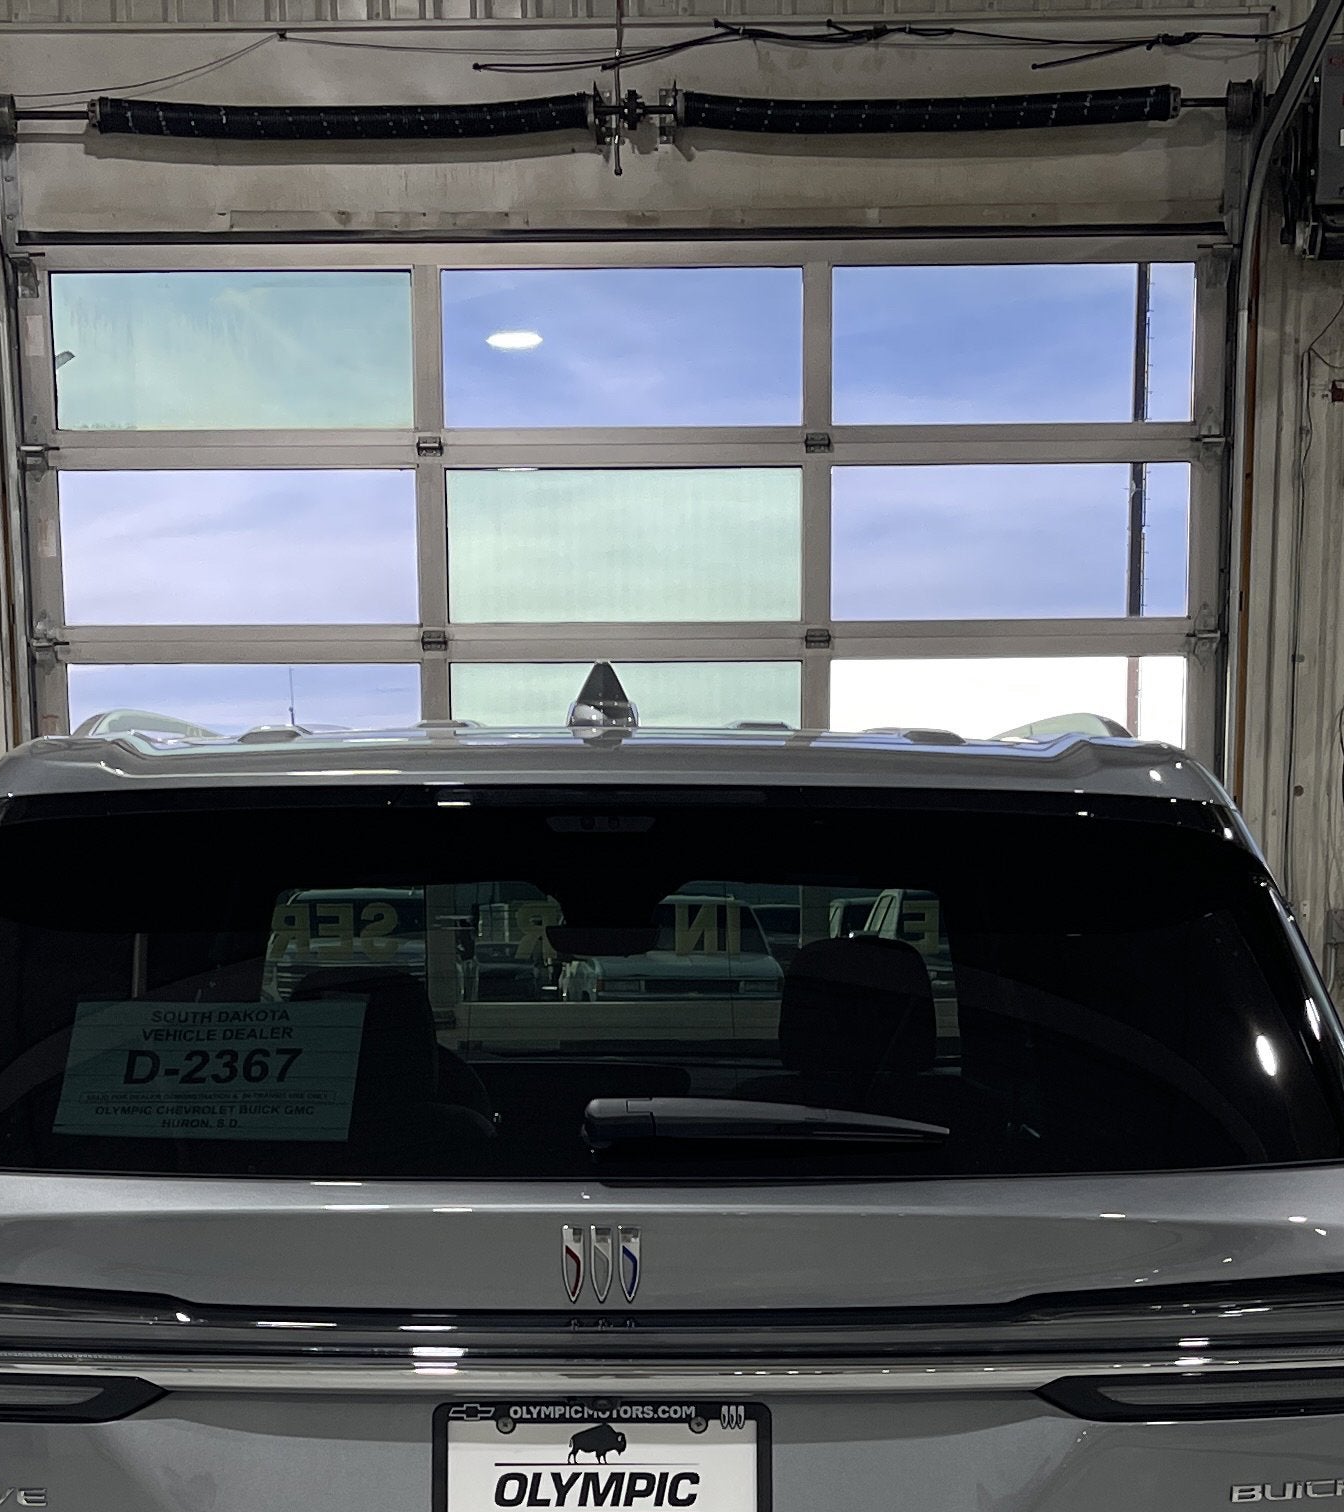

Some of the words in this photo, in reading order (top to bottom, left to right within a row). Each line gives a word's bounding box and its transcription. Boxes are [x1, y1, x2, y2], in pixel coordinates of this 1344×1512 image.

[151, 1010, 212, 1023] SOUTH
[218, 1010, 290, 1023] DAKOTA
[142, 1028, 216, 1041] VEHICLE
[222, 1027, 294, 1040] DEALER
[123, 1048, 304, 1085] D-2367
[95, 1105, 153, 1116] OLYMPIC
[157, 1105, 236, 1115] CHEVROLET
[239, 1105, 280, 1115] BUICK
[284, 1105, 315, 1115] GMC
[494, 1472, 700, 1507] OLYMPIC
